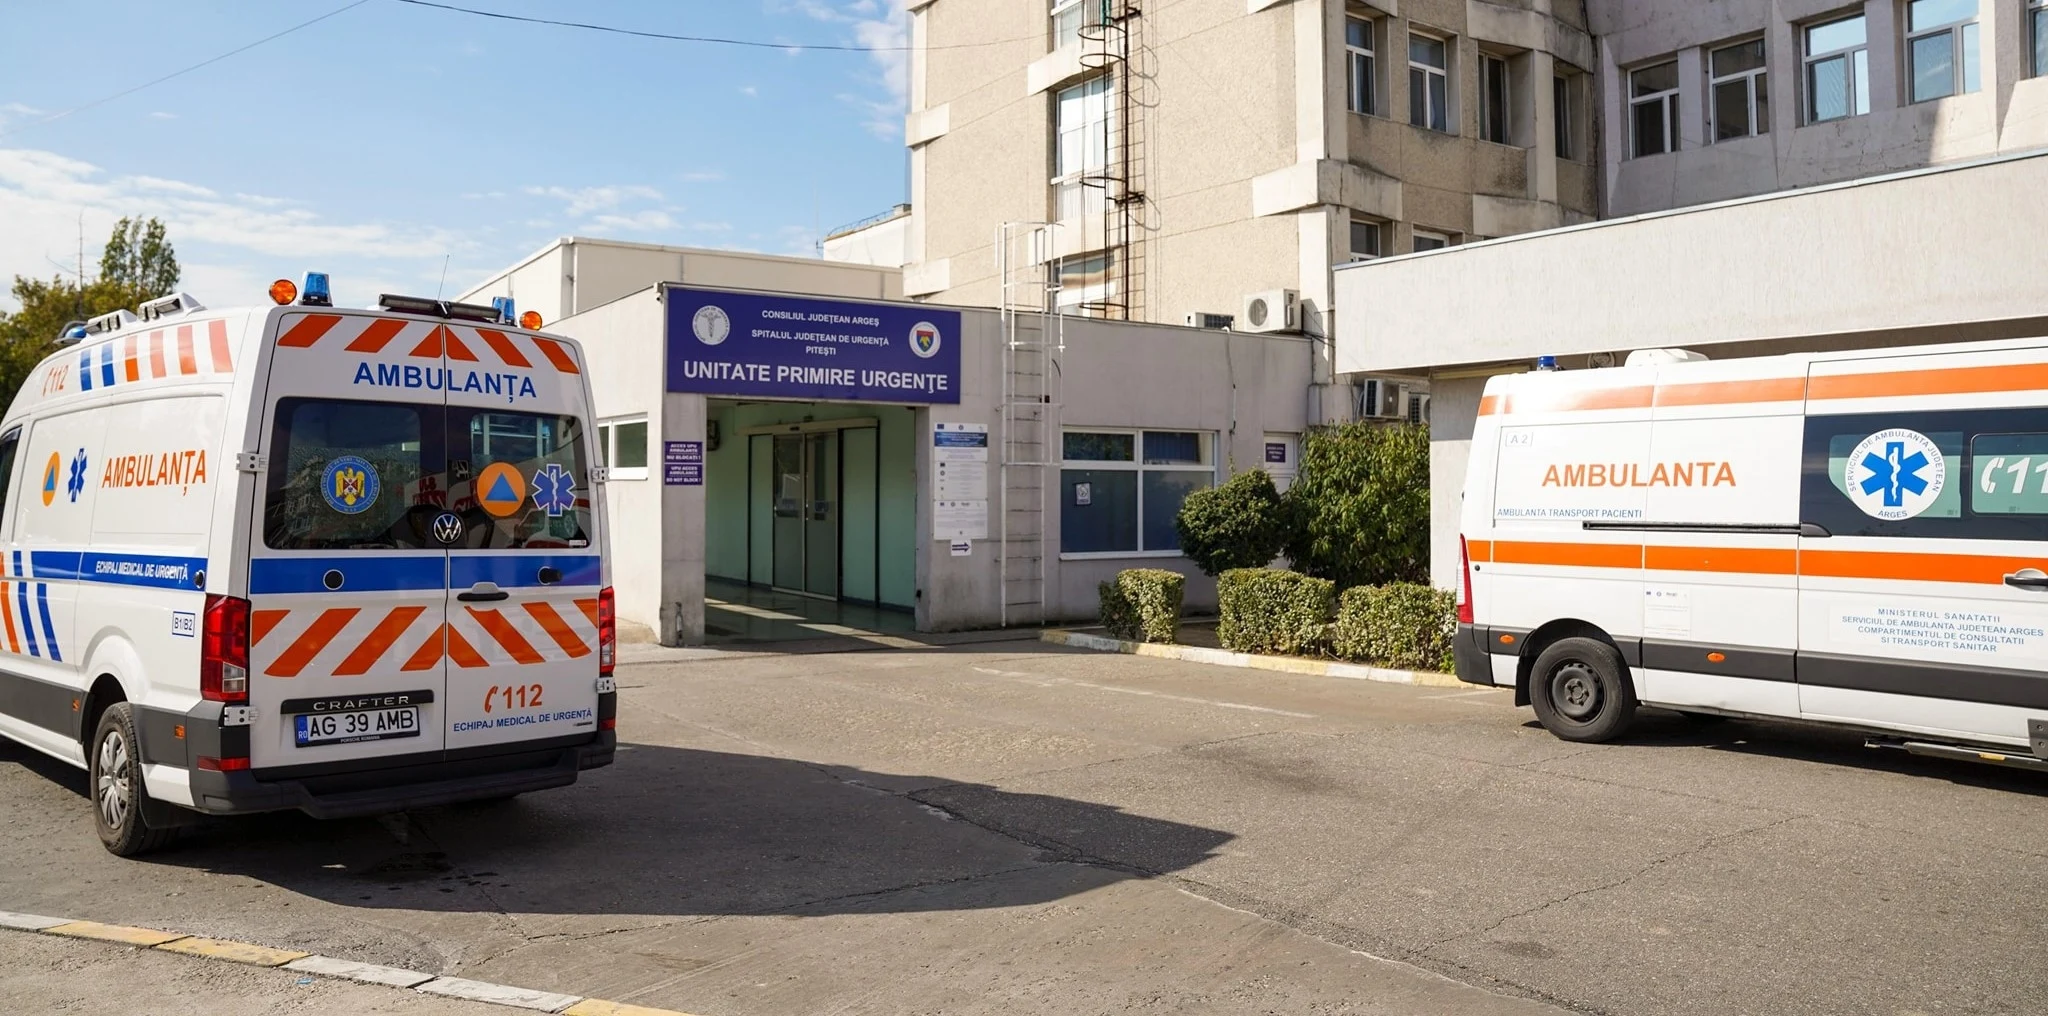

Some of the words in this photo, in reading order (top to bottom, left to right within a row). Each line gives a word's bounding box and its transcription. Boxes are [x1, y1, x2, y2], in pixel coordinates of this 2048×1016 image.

[762, 310, 806, 320] CONSILIUL
[752, 329, 792, 340] SPITALUL
[839, 335, 849, 343] DE
[49, 364, 69, 394] 112
[684, 360, 770, 382] UNITATE
[777, 365, 855, 387] PRIMIRE
[1847, 449, 1863, 492] SERVICIUL
[1862, 440, 1874, 449] DE
[1874, 430, 1929, 448] AMBULANTA
[1927, 447, 1944, 493] JUDETEAN
[1542, 462, 1736, 487] AMBULANTA
[1497, 508, 1546, 517] AMBULANTA
[1548, 509, 1599, 517] TRANSPORT
[1602, 509, 1642, 518] PACIENTI
[1878, 510, 1908, 518] ARGES
[95, 560, 118, 574] ECHIPAJ
[118, 562, 143, 577] MEDICAL
[144, 563, 155, 578] DE
[1878, 608, 1940, 619] MINISTERUL
[1944, 612, 2000, 623] SANATATII
[1842, 616, 1885, 626] SERVICIUL
[1886, 618, 1899, 626] DE
[1900, 620, 1955, 630] AMBULANTA
[1957, 624, 2007, 634] JUDETEAN
[2009, 627, 2044, 637] ARGES
[1858, 626, 1941, 639] COMPARTIMENTUL
[1944, 632, 1957, 640] DE
[1959, 633, 2025, 645] CONSULTATII
[1881, 636, 1890, 644] SI
[1892, 637, 1950, 648] TRANSPORT
[1953, 642, 1997, 652] SANITAR
[313, 695, 409, 711] CRAFTER
[502, 684, 543, 709] 112
[298, 730, 308, 740] RO
[310, 716, 337, 737] AG
[345, 713, 369, 733] 39
[376, 710, 414, 731] AMB
[454, 720, 493, 732] ECHIPAJ
[496, 714, 536, 727] MEDICAL
[539, 713, 551, 723] DE
